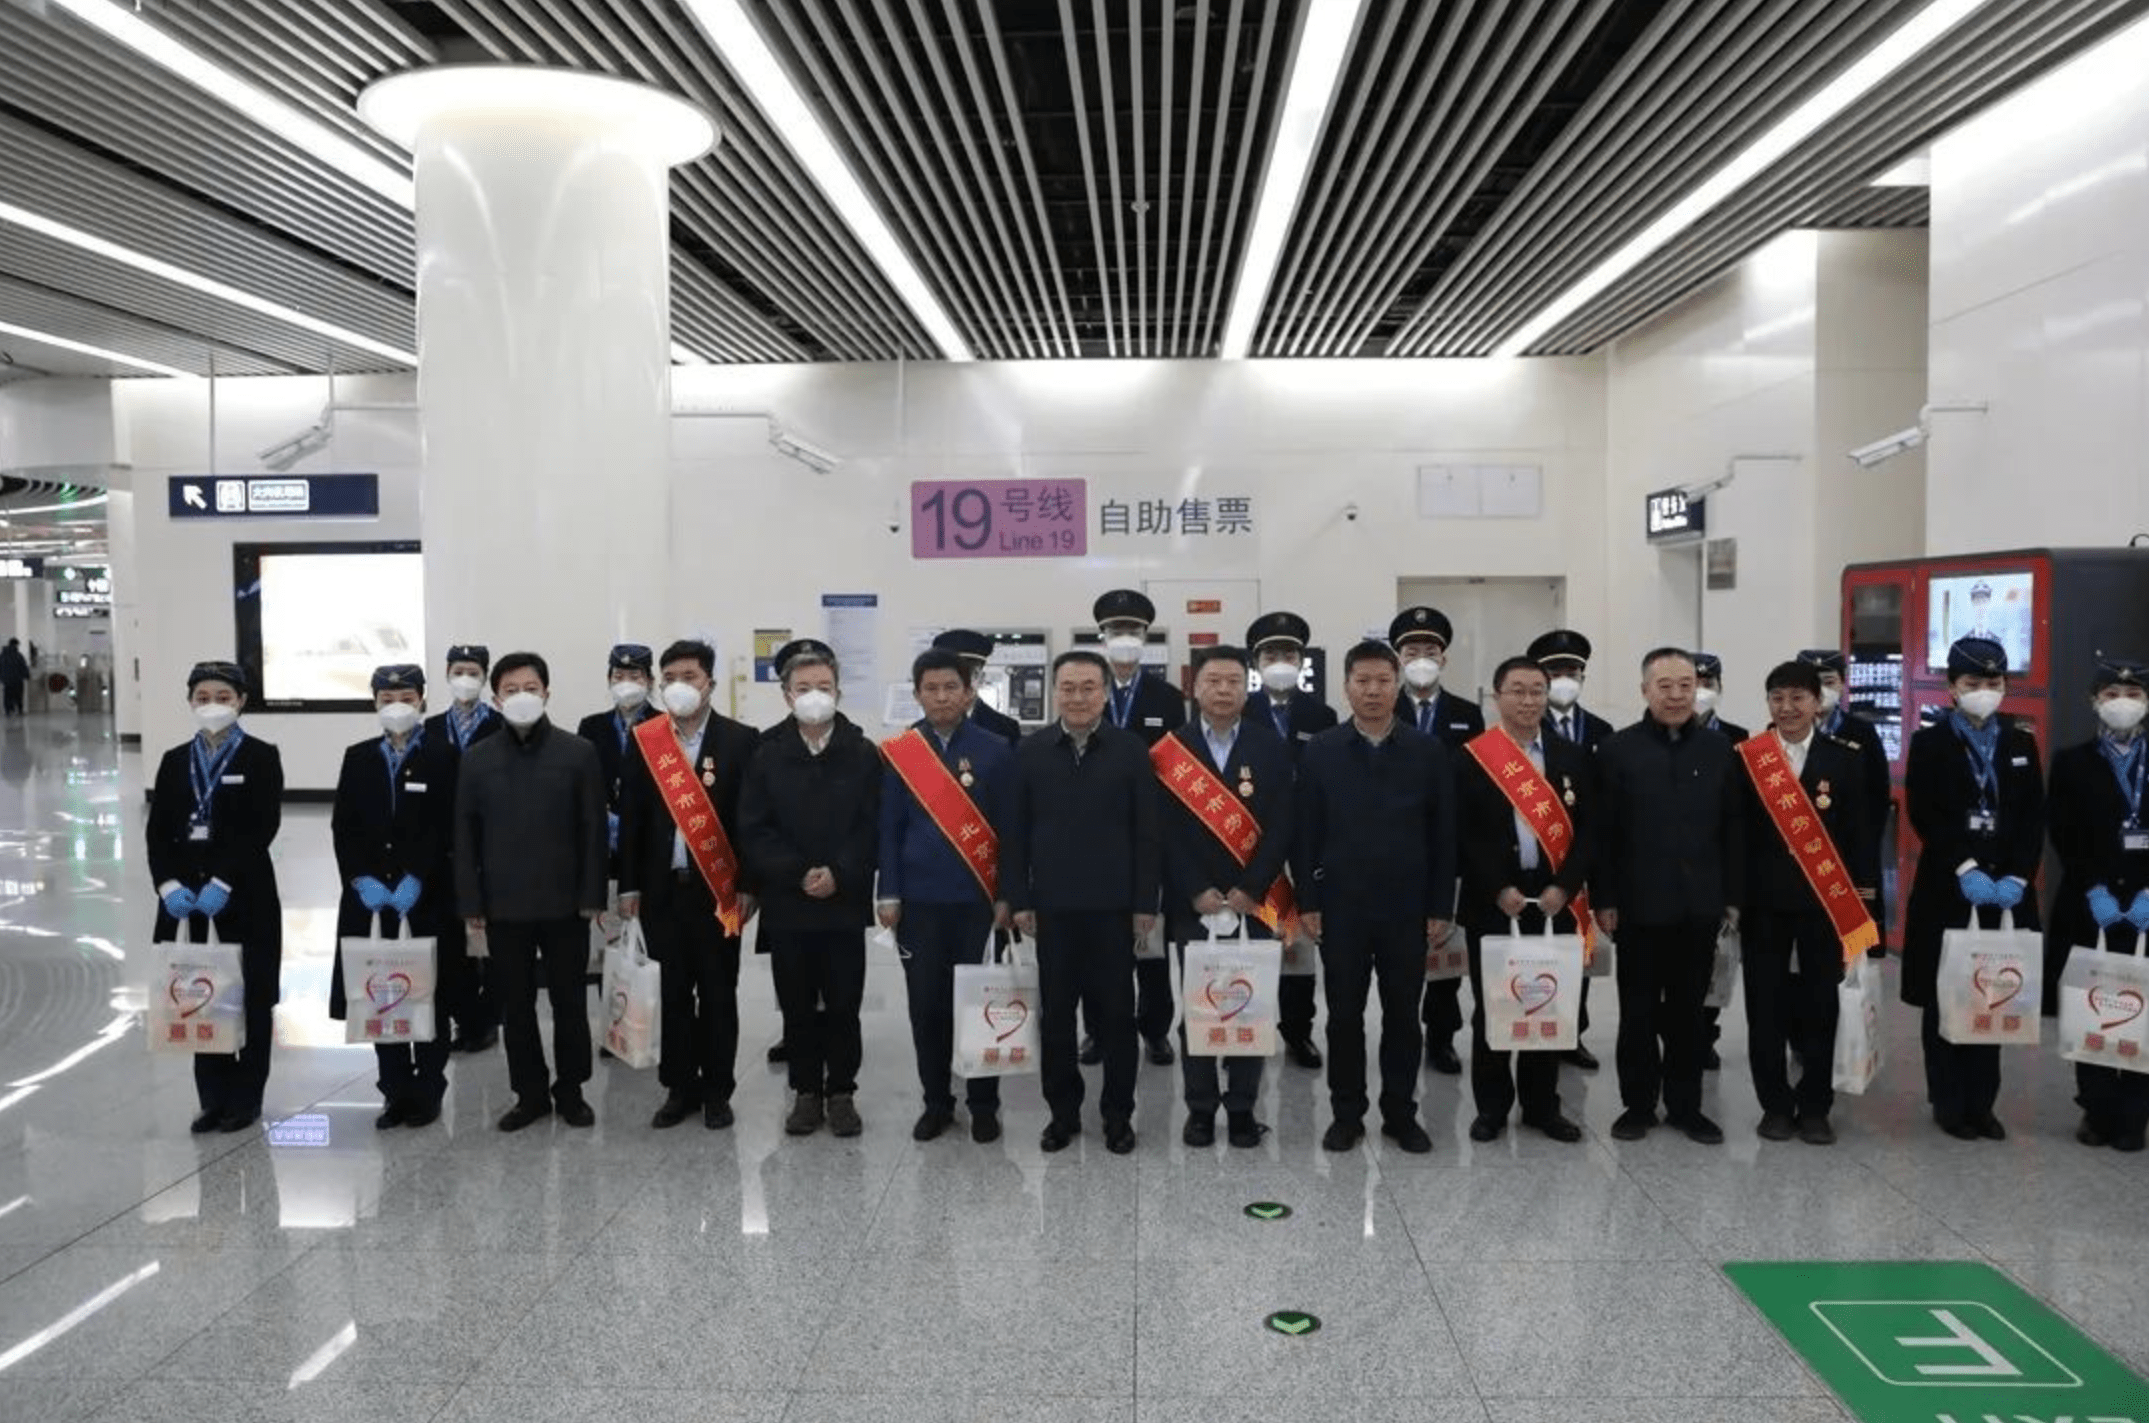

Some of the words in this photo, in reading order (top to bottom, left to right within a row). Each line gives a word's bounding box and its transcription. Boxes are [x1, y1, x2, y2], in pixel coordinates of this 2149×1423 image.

[921, 488, 992, 551] 19
[1100, 497, 1252, 535] 自助售票
[1001, 531, 1044, 552] Line
[1052, 529, 1076, 551] 19
